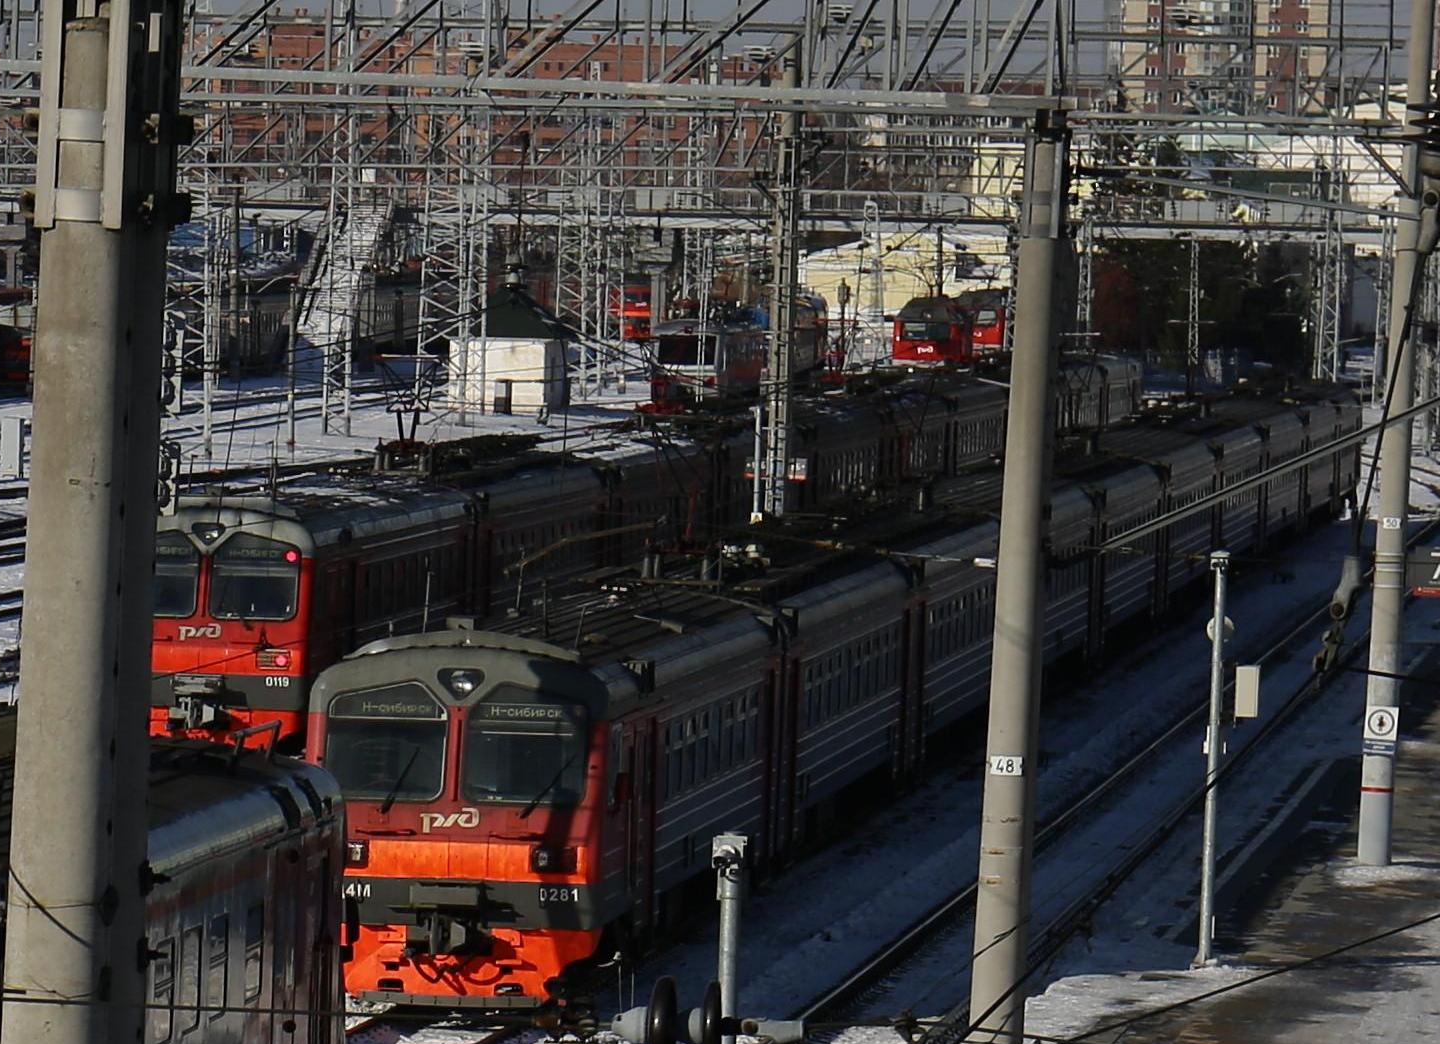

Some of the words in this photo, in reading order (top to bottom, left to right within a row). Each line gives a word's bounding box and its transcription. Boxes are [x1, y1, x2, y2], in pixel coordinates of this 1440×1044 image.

[265, 676, 290, 688] 0119
[995, 758, 1015, 774] 48
[342, 883, 371, 899] 4М
[539, 887, 579, 902] 0281
